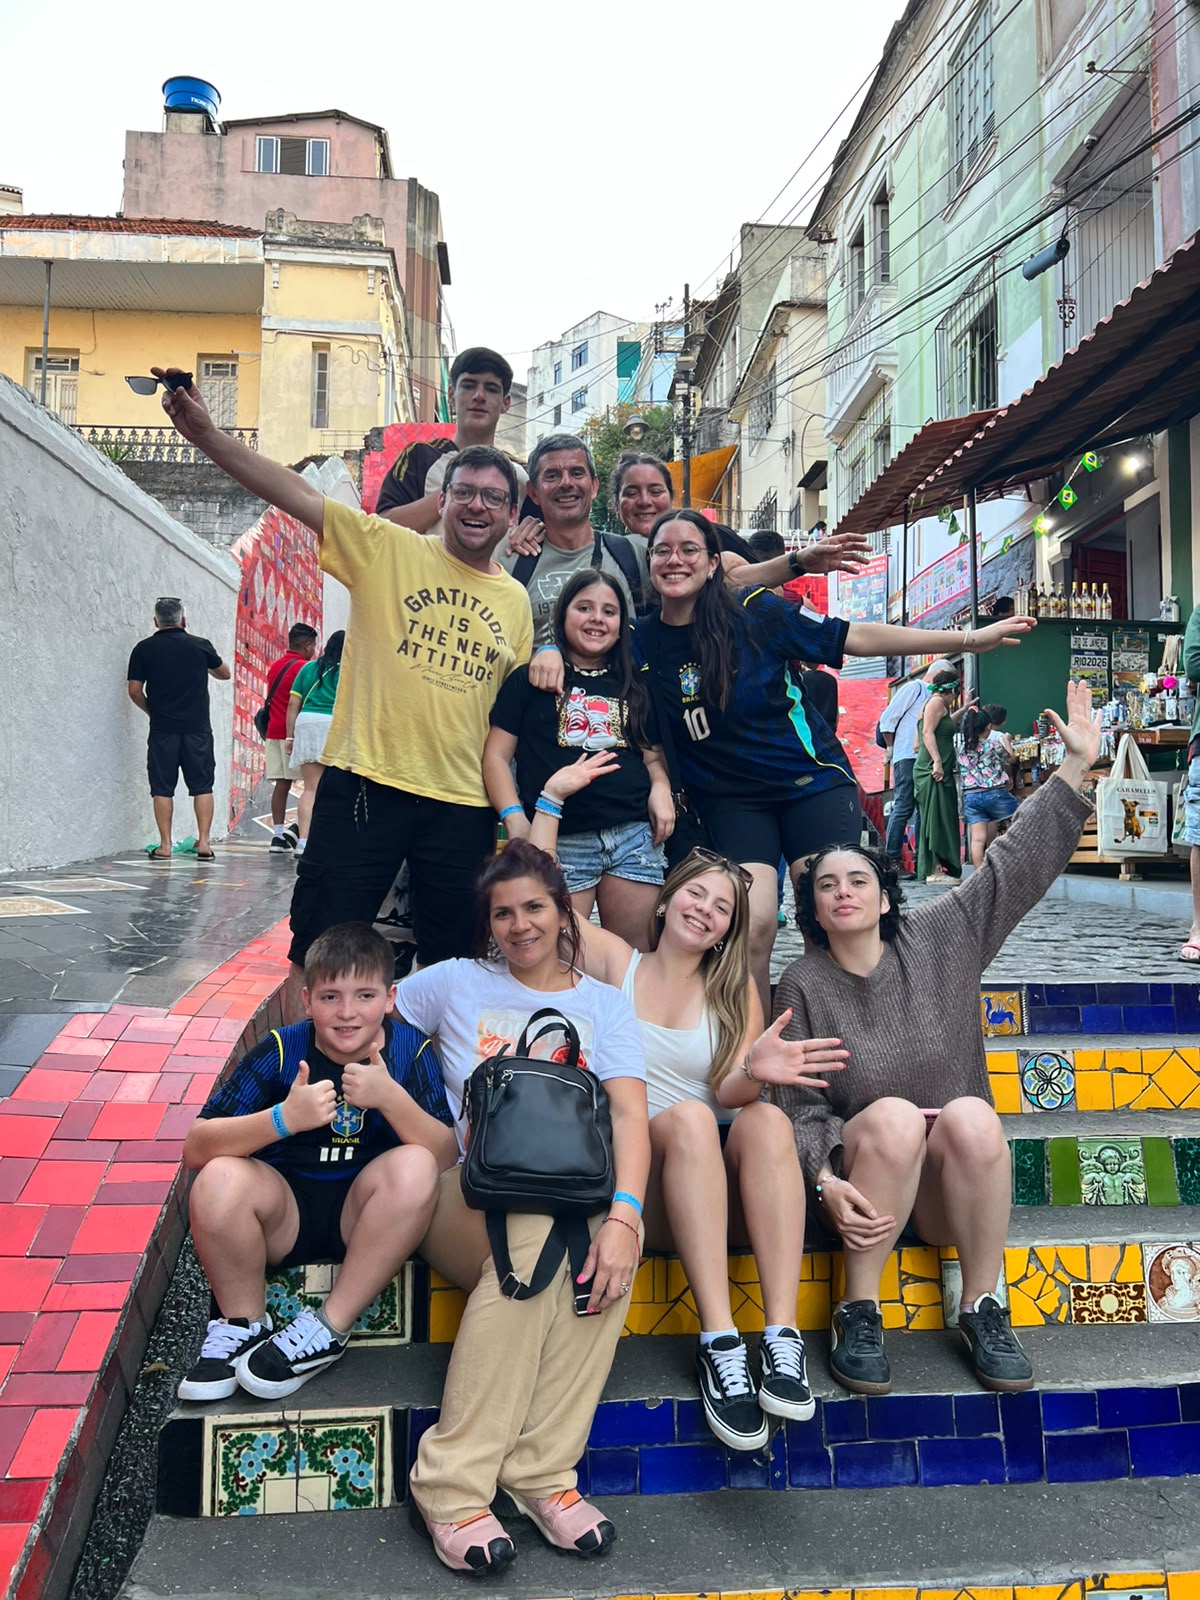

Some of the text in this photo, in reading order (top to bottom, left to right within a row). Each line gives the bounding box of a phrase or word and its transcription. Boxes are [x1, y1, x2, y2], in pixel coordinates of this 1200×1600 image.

[403, 587, 507, 646] GRATITUDE
[449, 614, 470, 633] IS
[408, 619, 500, 665] THE NEW
[683, 706, 711, 741] 10
